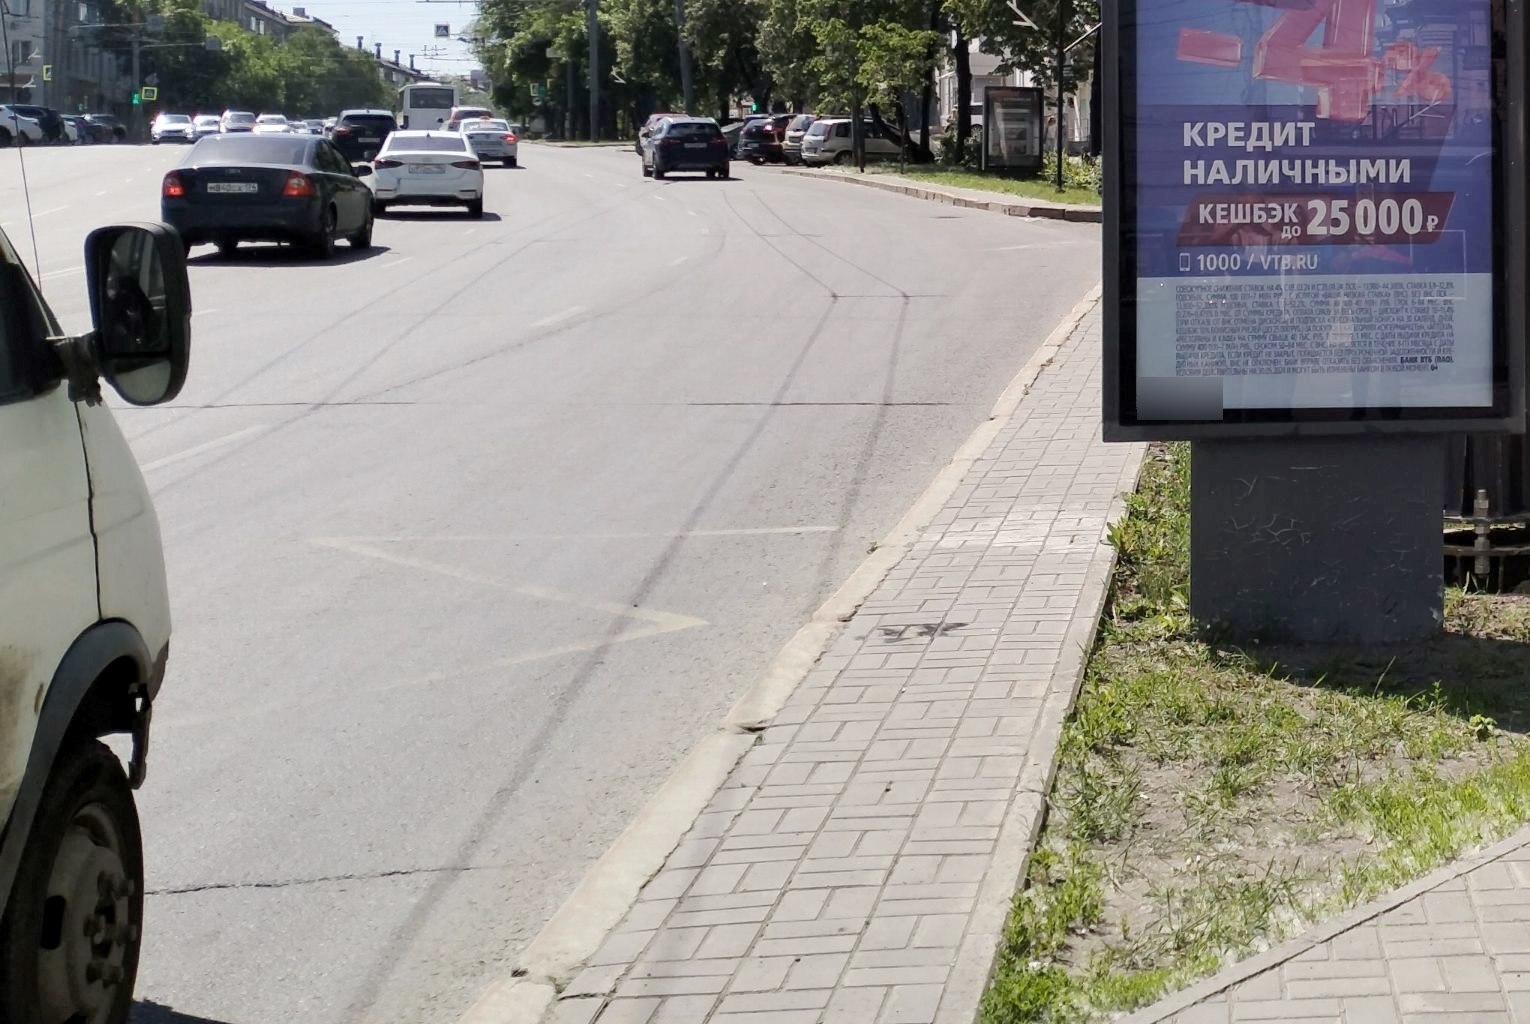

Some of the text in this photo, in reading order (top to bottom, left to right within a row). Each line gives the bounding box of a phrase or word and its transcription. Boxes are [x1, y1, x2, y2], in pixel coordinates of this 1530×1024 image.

[1183, 121, 1316, 152] КРЕДИТ
[1183, 158, 1411, 185] НАЛИЧНЫМИ
[1198, 202, 1299, 224] КЕШБЭК
[1197, 253, 1241, 271] 1000
[1260, 253, 1319, 270] VTB.RU
